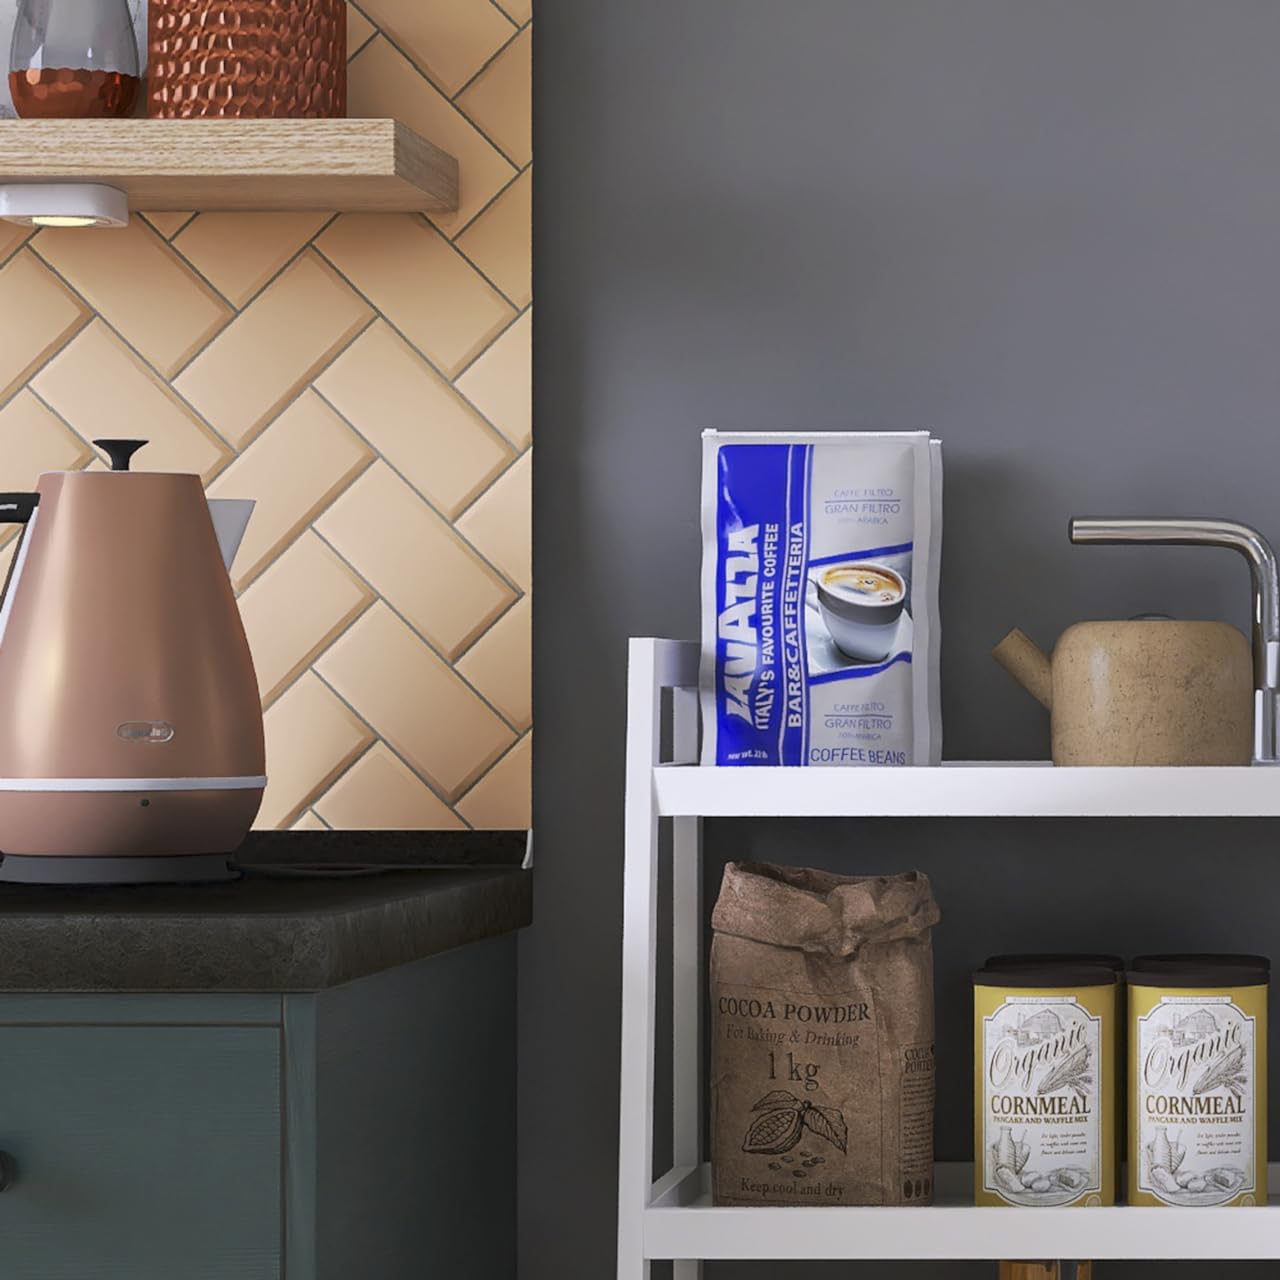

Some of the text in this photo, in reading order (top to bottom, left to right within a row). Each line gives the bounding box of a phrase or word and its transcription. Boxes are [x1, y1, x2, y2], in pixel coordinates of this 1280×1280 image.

[824, 503, 900, 514] GRAN FILTRO
[718, 523, 759, 727] LAVAZZA
[755, 523, 779, 730] ITALY'S FAVOURITE COFFEE
[784, 522, 803, 728] BAR&CAFFETTERIA
[824, 718, 892, 730] GRAN FILTRO
[810, 747, 906, 766] COFFEE BEANS
[718, 996, 871, 1024] COCOA POWDER
[747, 1026, 786, 1046] Baking
[789, 1030, 801, 1044] &
[804, 1031, 860, 1049] Drinking
[988, 1018, 1088, 1092] Organic
[1142, 1018, 1242, 1091] Organic
[786, 1052, 821, 1092] kg
[991, 1095, 1091, 1115] CORNMEAL
[1145, 1095, 1246, 1115] CORNMEAL
[992, 1116, 1024, 1125] PANCAKE
[1025, 1117, 1042, 1125] AND
[1148, 1116, 1178, 1125] PANCAKE
[1180, 1117, 1197, 1125] AND
[741, 1177, 845, 1202] Keep cool and dry
